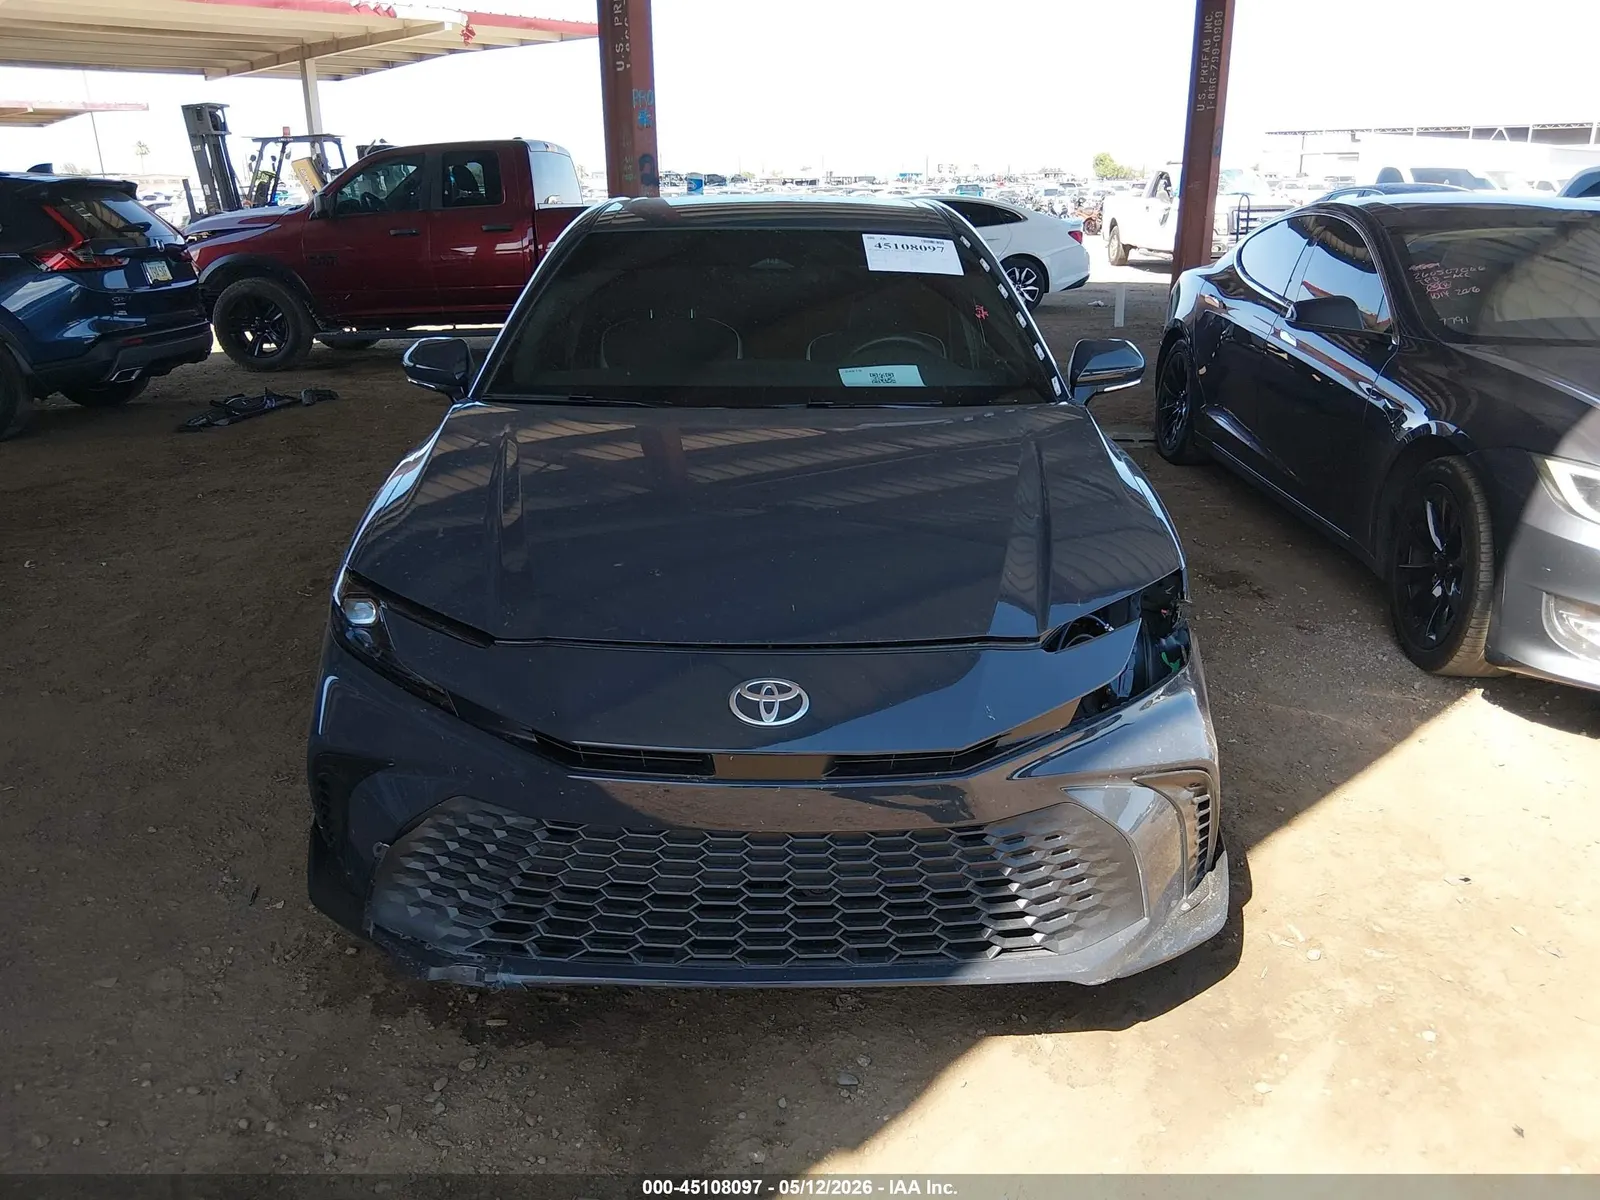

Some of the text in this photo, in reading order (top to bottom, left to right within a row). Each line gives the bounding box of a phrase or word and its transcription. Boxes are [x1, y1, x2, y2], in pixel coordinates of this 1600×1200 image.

[613, 0, 625, 72] U.S. PR
[1196, 11, 1214, 112] U.S. PREFAB INC.
[1206, 11, 1223, 110] 1-866-799-0969
[874, 242, 945, 253] 45108097
